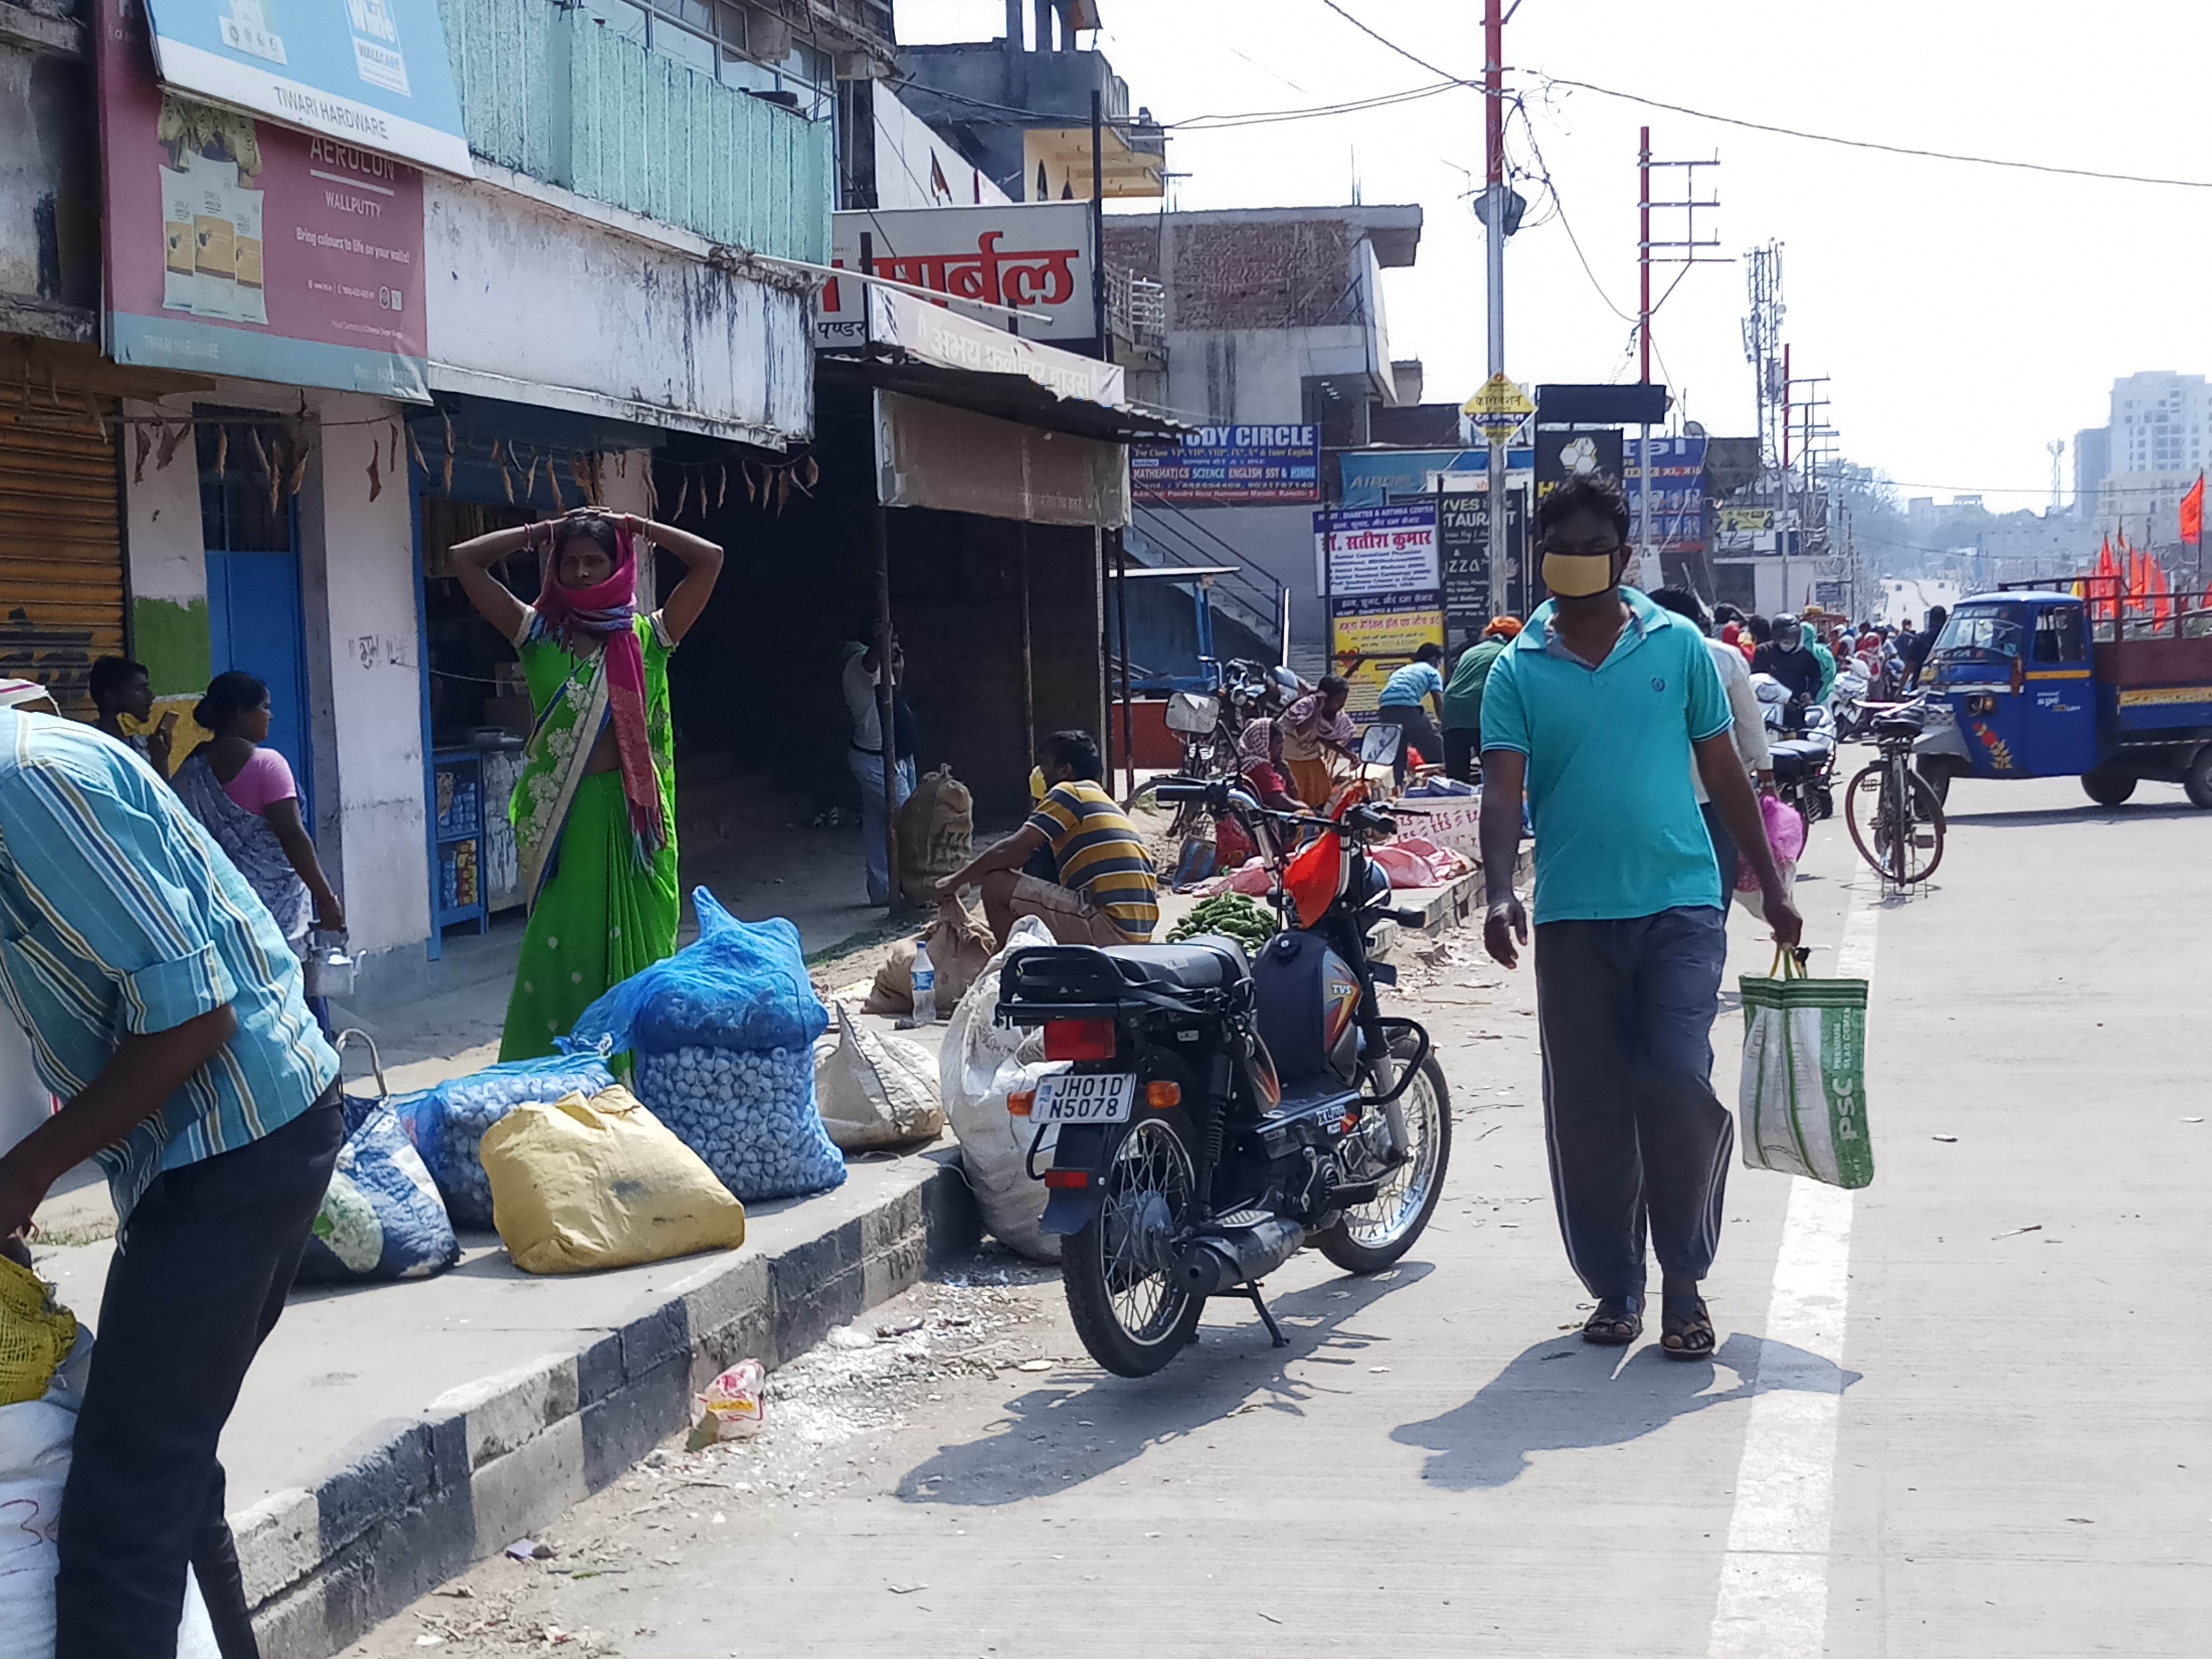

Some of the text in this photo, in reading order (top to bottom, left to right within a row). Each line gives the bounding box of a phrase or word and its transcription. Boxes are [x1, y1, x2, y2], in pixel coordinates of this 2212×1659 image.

[274, 86, 388, 140] TIWARI HARDWARE
[325, 191, 382, 218] WALLPUTTY
[296, 227, 316, 246] Bring
[318, 233, 343, 250] colours
[345, 238, 352, 250] to
[375, 248, 390, 259] your
[931, 327, 982, 368] अभय
[1236, 427, 1313, 446] CIRCLE
[1133, 468, 1190, 480] MATHEMATICS
[1192, 467, 1225, 479] SCIENCE
[1229, 468, 1262, 479] ENGLISH
[1265, 468, 1280, 479] SST
[1346, 531, 1389, 550] सतीश
[1392, 530, 1432, 550] कुमार
[1331, 984, 1352, 995] TVS
[1055, 1077, 1123, 1097] JH01D
[1049, 1098, 1119, 1118] N5078
